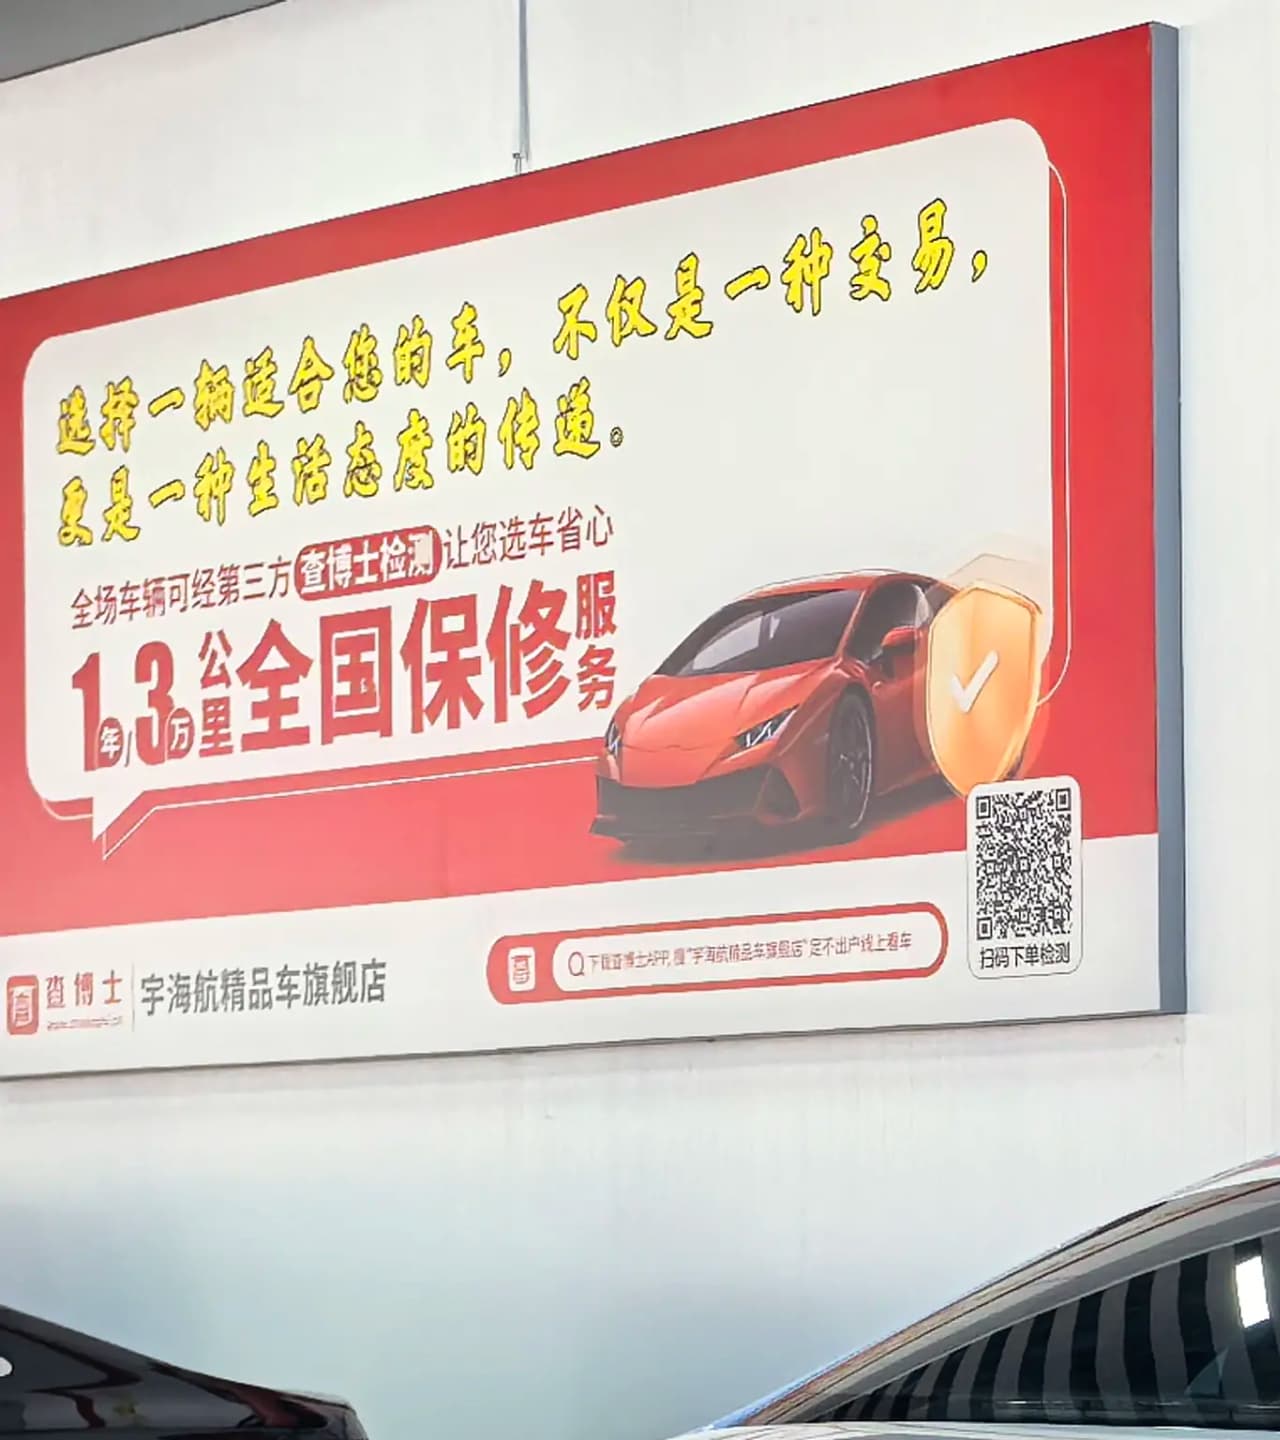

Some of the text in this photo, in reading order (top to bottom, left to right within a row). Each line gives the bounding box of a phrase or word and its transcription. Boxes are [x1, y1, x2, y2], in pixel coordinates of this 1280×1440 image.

[980, 941, 1071, 970] 扫码下单检测
[140, 957, 387, 1017] 宇海航精品车旗舰店
